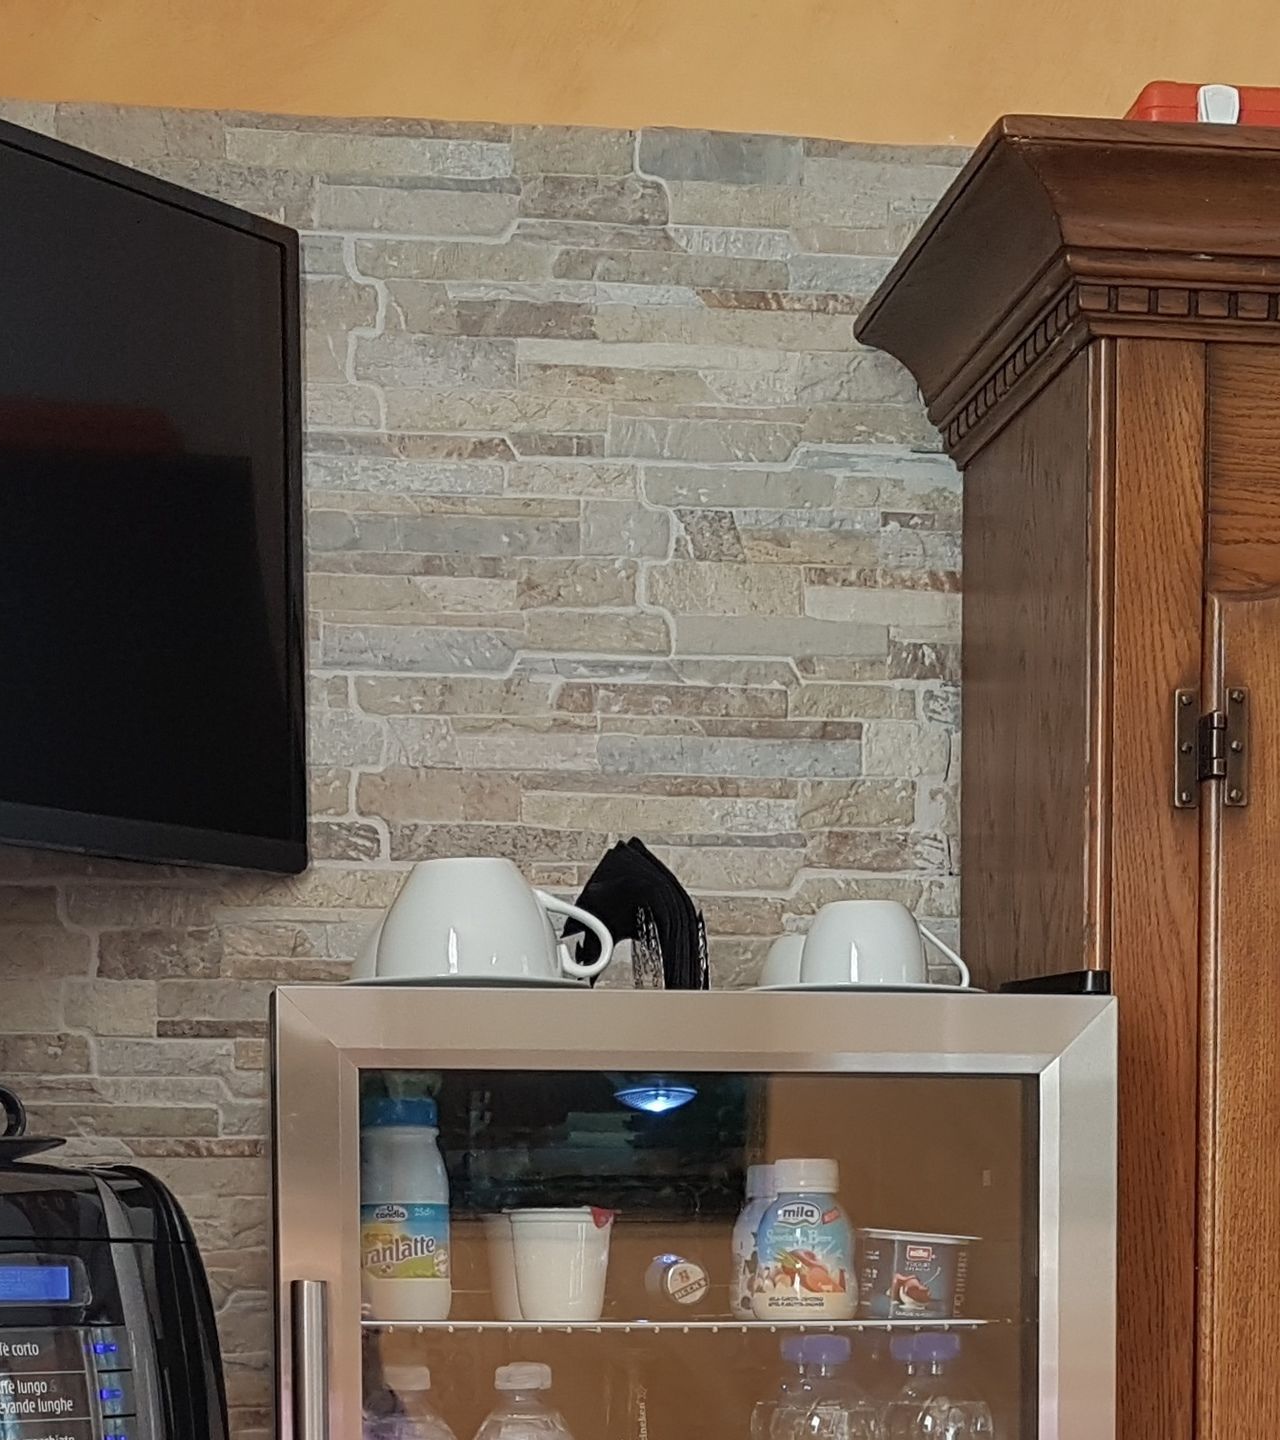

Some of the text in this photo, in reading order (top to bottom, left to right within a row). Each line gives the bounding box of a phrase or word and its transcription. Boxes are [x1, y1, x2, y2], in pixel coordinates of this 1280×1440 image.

[783, 1206, 815, 1220] mila
[11, 1343, 39, 1356] corto
[17, 1380, 47, 1394] lungo
[38, 1398, 73, 1415] lunghe
